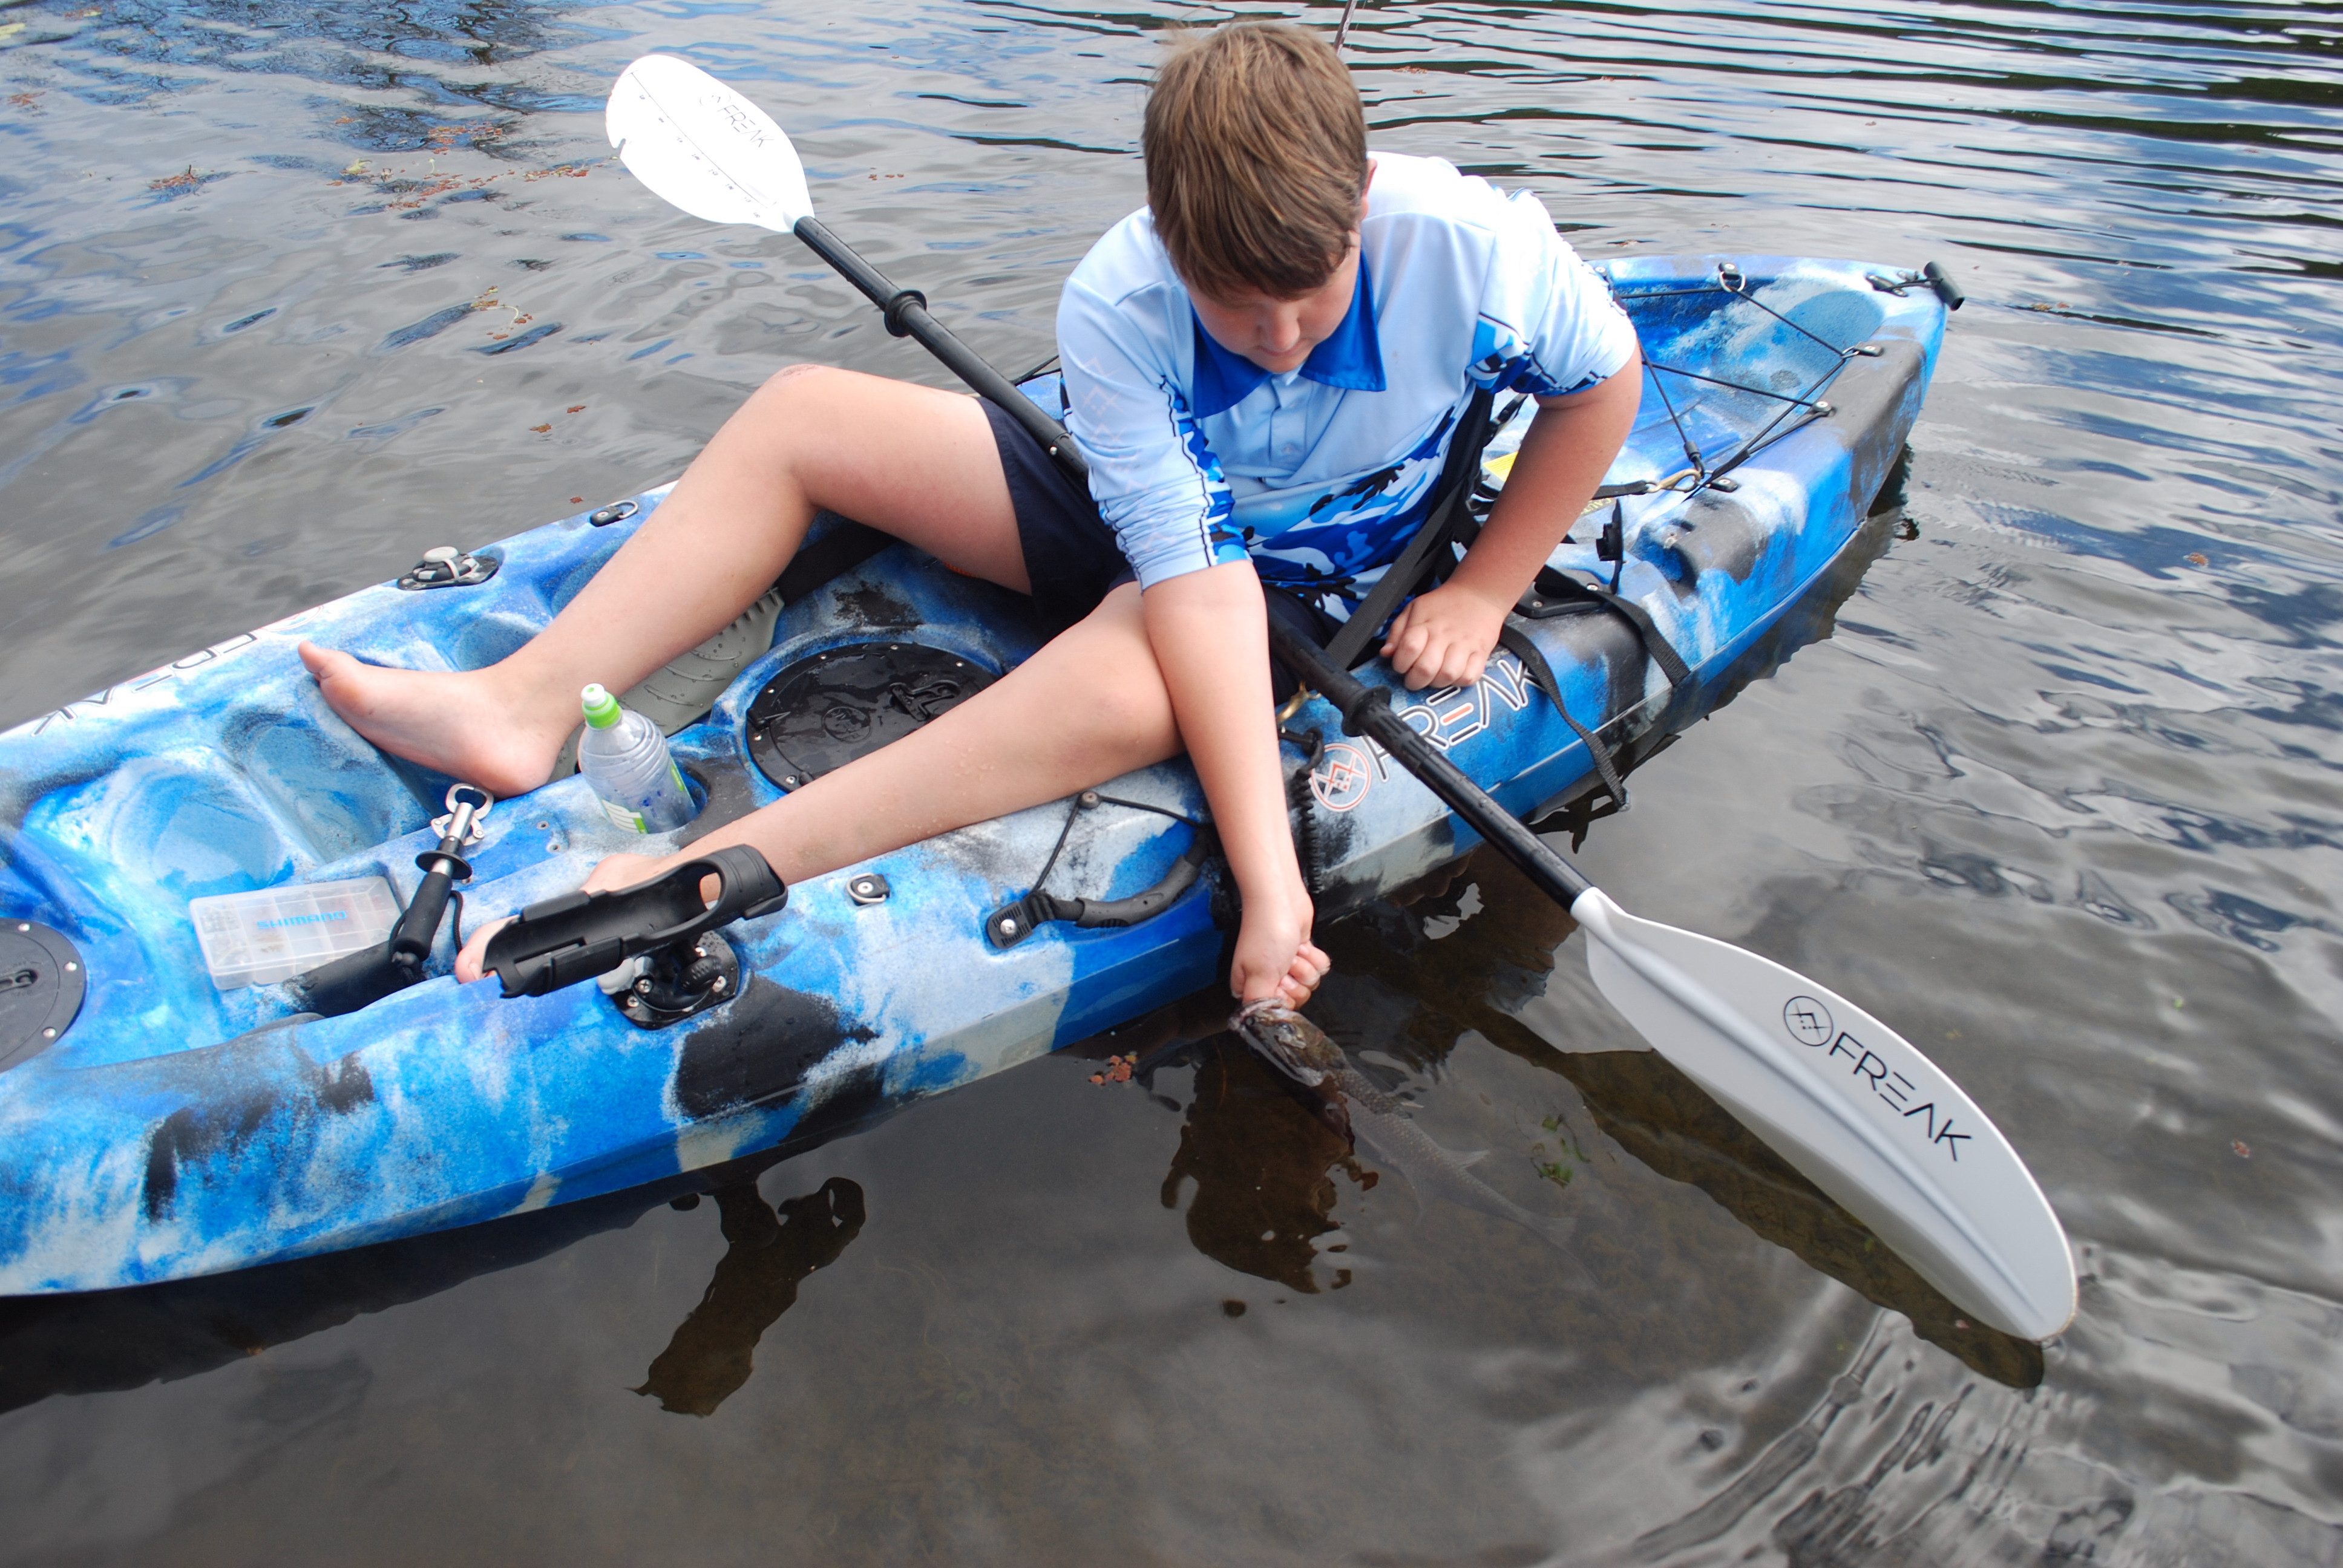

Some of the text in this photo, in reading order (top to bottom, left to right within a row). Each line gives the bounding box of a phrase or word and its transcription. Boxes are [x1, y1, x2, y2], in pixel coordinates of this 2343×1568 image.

[717, 104, 775, 148] FREAK
[257, 910, 347, 929] SHIMANO
[1829, 1031, 1972, 1162] FREAK
